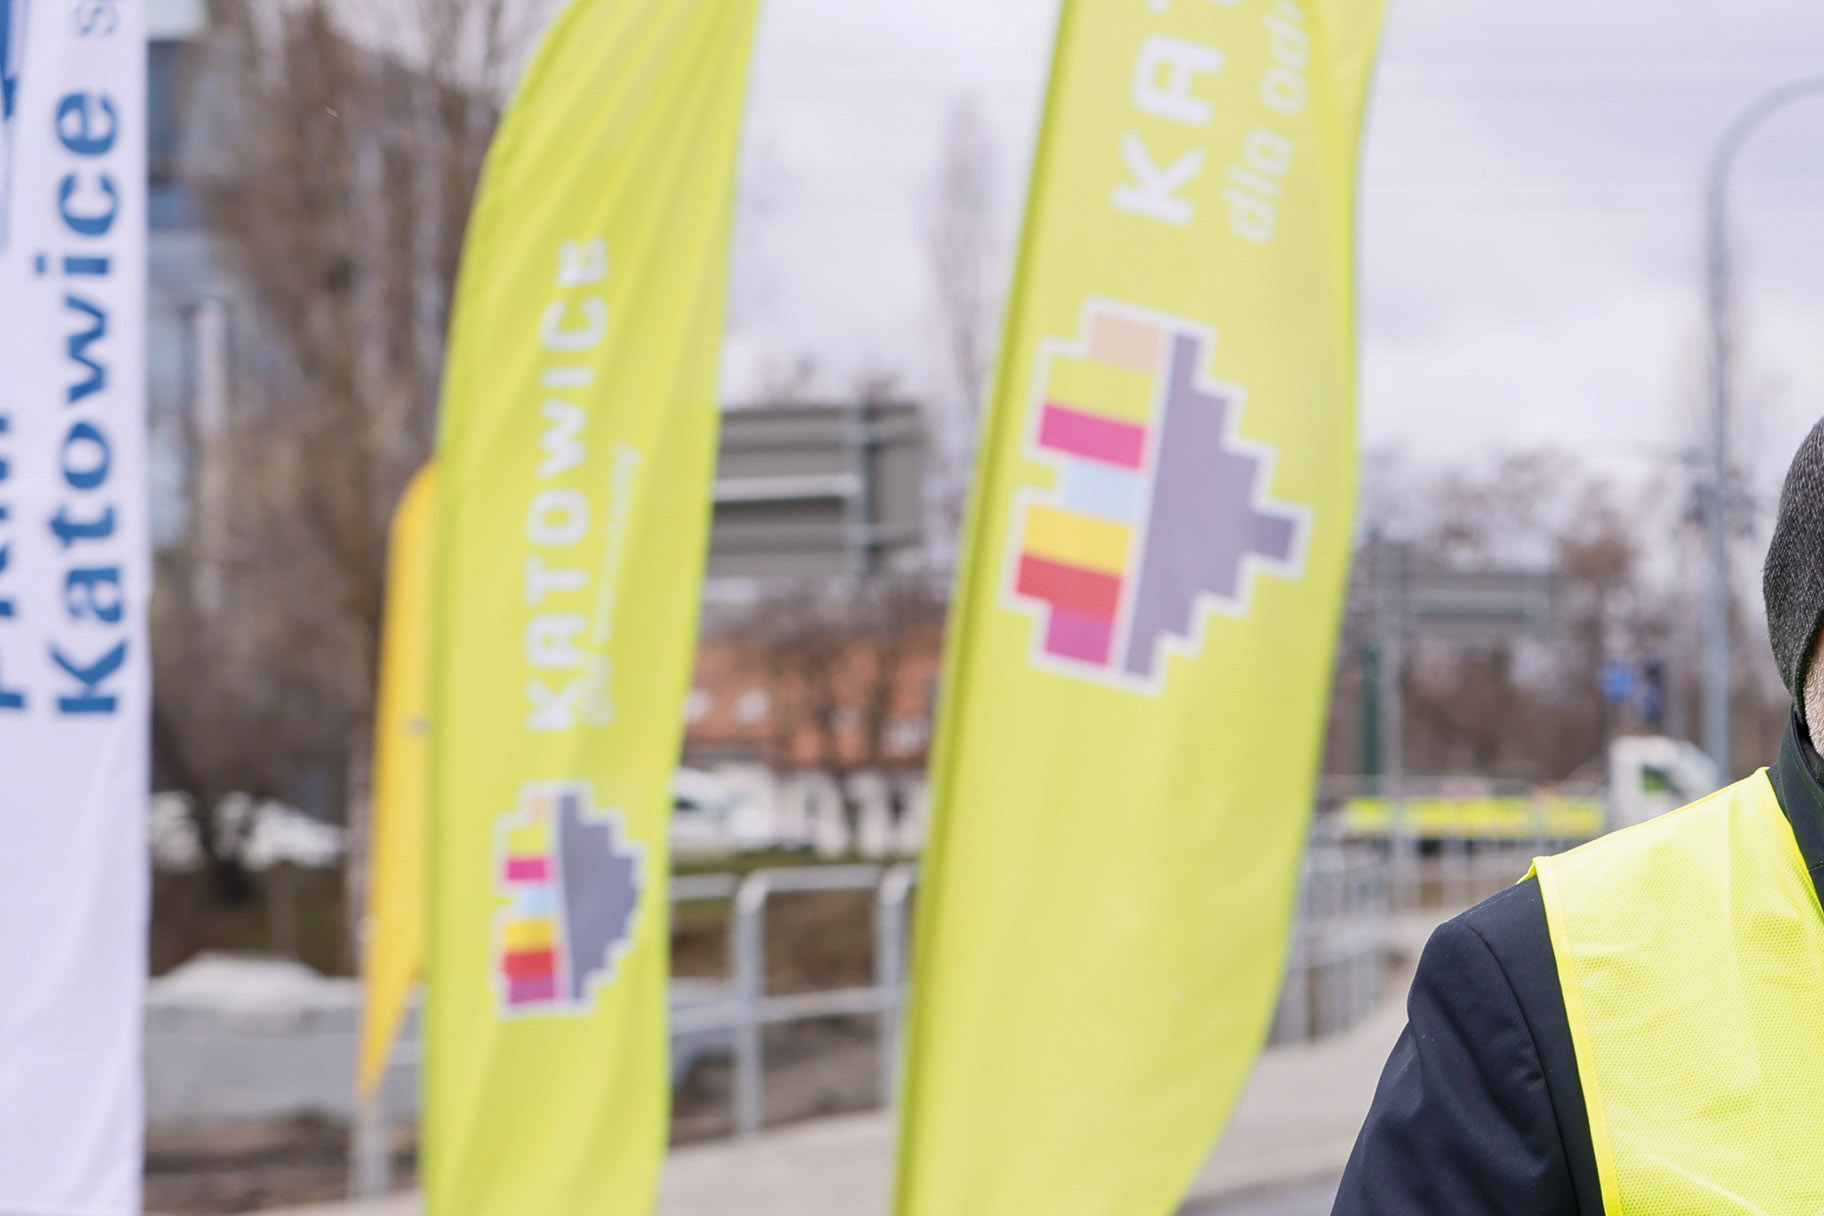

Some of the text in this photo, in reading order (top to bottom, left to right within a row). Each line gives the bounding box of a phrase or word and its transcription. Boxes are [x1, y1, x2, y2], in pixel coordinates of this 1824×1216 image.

[1109, 0, 1230, 227] KA
[1219, 126, 1295, 243] dla
[35, 93, 126, 713] Katowice
[523, 237, 610, 732] KATOWICE
